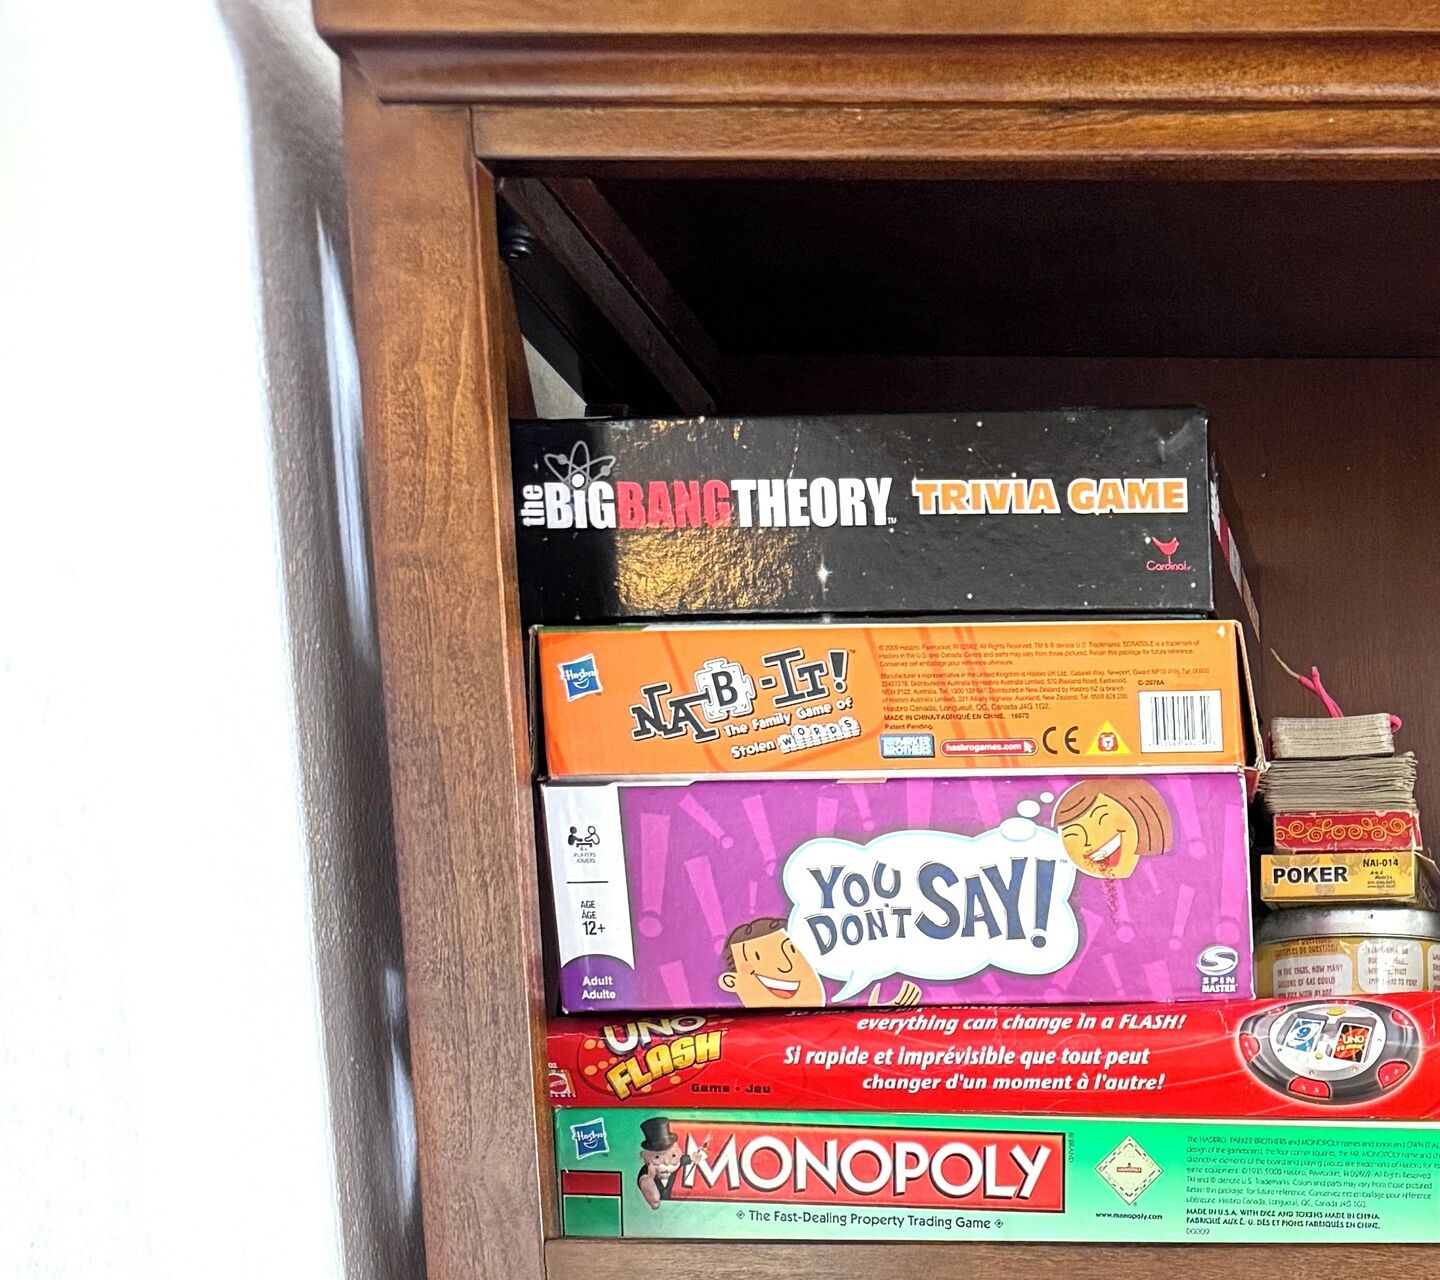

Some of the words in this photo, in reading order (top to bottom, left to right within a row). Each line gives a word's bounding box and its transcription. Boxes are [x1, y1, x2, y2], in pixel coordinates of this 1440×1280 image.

[520, 483, 546, 527] the
[616, 479, 732, 531] BANG
[729, 477, 894, 529] THEORY
[912, 477, 1061, 515] TRIVIA
[1067, 476, 1189, 515] GAME
[1146, 559, 1188, 573] Cardinal
[723, 724, 749, 738] The
[752, 713, 791, 733] Family
[796, 702, 832, 720] Game
[837, 697, 853, 711] of
[731, 739, 776, 760] Stolen
[945, 742, 1022, 753] hasbrogames.com
[1363, 858, 1399, 868] NAI-014
[806, 861, 900, 910] YOU
[1273, 867, 1348, 884] POKER
[914, 856, 1059, 949] SAY!
[582, 921, 606, 936] 12+
[808, 902, 912, 953] DON'T
[582, 976, 613, 987] Adult
[1202, 984, 1238, 992] MASTER
[582, 989, 617, 1001] Adulte
[856, 1015, 958, 1035] everything
[962, 1016, 997, 1031] can
[1003, 1014, 1073, 1032] change
[1076, 1013, 1097, 1030] in
[1101, 1016, 1114, 1030] a
[1118, 1013, 1186, 1030] FLASH!
[605, 1029, 722, 1101] FLASH
[783, 1047, 801, 1064] Si
[805, 1047, 869, 1068] rapide
[873, 1049, 892, 1064] et
[897, 1045, 1016, 1068] imprévisible
[1019, 1051, 1058, 1068] que
[1062, 1049, 1101, 1064] tout
[1104, 1049, 1150, 1068] peut
[684, 1132, 1051, 1200] MONOPOLY
[748, 1210, 771, 1223] The
[773, 1210, 847, 1228] Fast-Dealing
[849, 1213, 904, 1230] Property
[906, 1214, 953, 1230] Trading
[955, 1216, 992, 1229] Game
